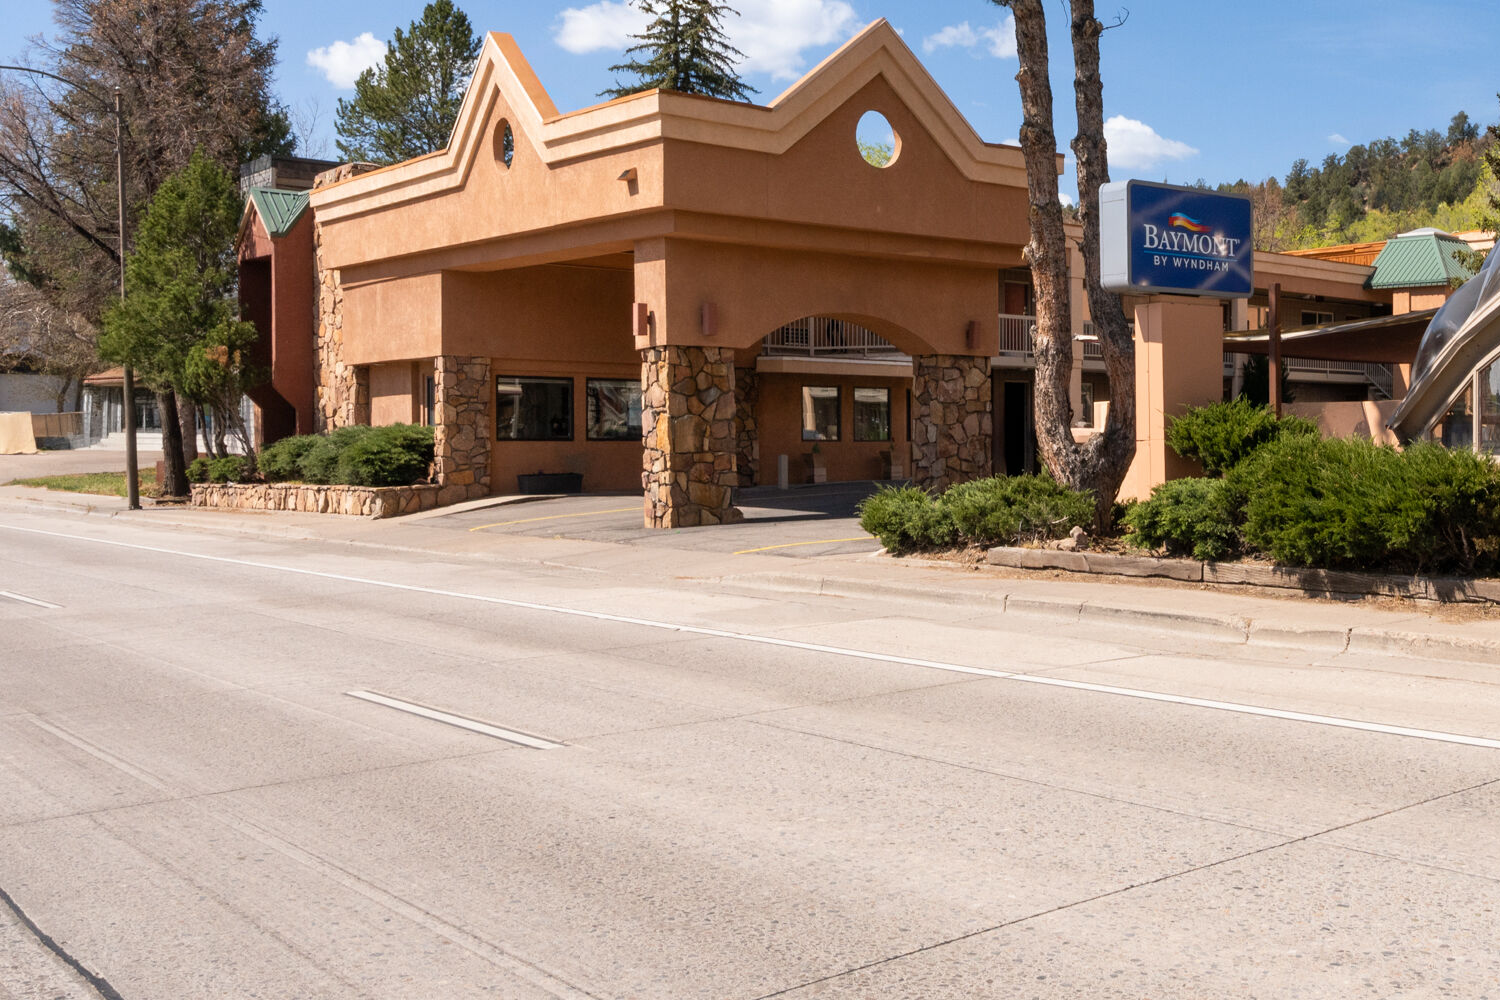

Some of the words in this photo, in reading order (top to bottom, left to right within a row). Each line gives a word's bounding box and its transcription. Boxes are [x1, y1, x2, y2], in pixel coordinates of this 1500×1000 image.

[1143, 223, 1238, 257] BAYMONT
[1153, 255, 1168, 266] BY
[1173, 257, 1229, 272] WYNDHAM
